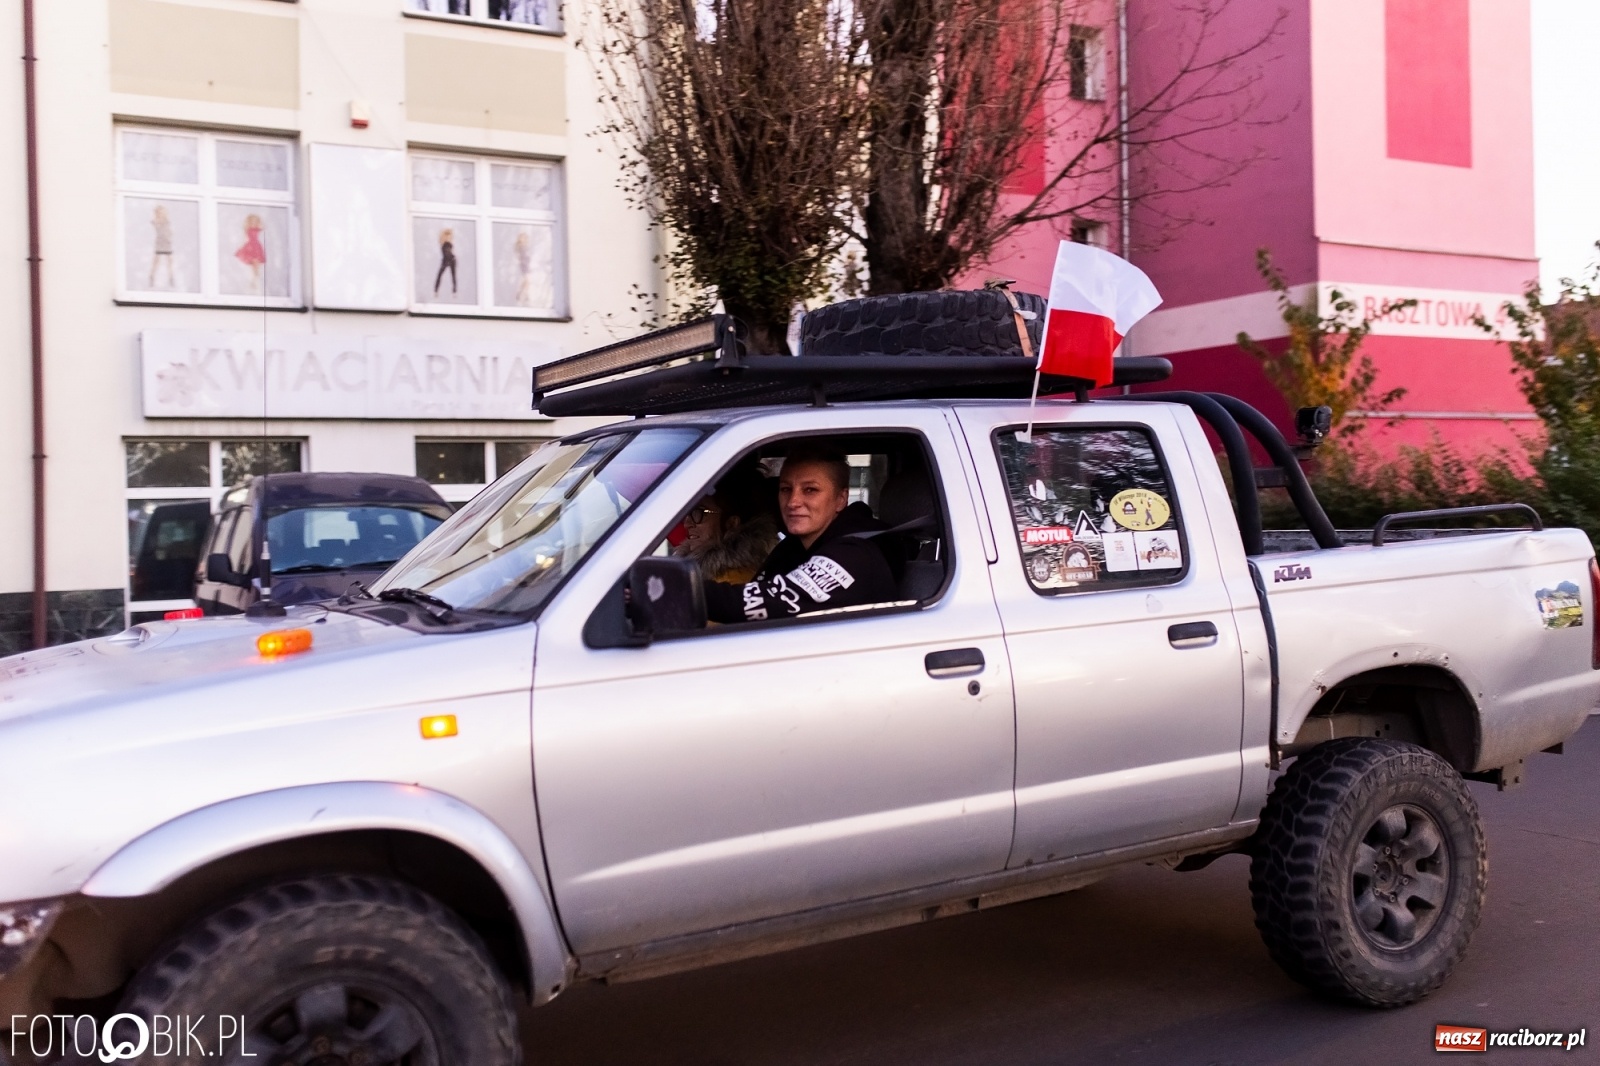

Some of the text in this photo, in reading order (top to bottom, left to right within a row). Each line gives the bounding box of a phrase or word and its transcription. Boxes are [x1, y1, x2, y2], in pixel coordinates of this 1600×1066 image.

[1363, 296, 1485, 328] BASZTOWA
[190, 348, 533, 395] KWIACIARNIA
[1026, 528, 1071, 544] MOTUL
[1274, 563, 1312, 583] KTM
